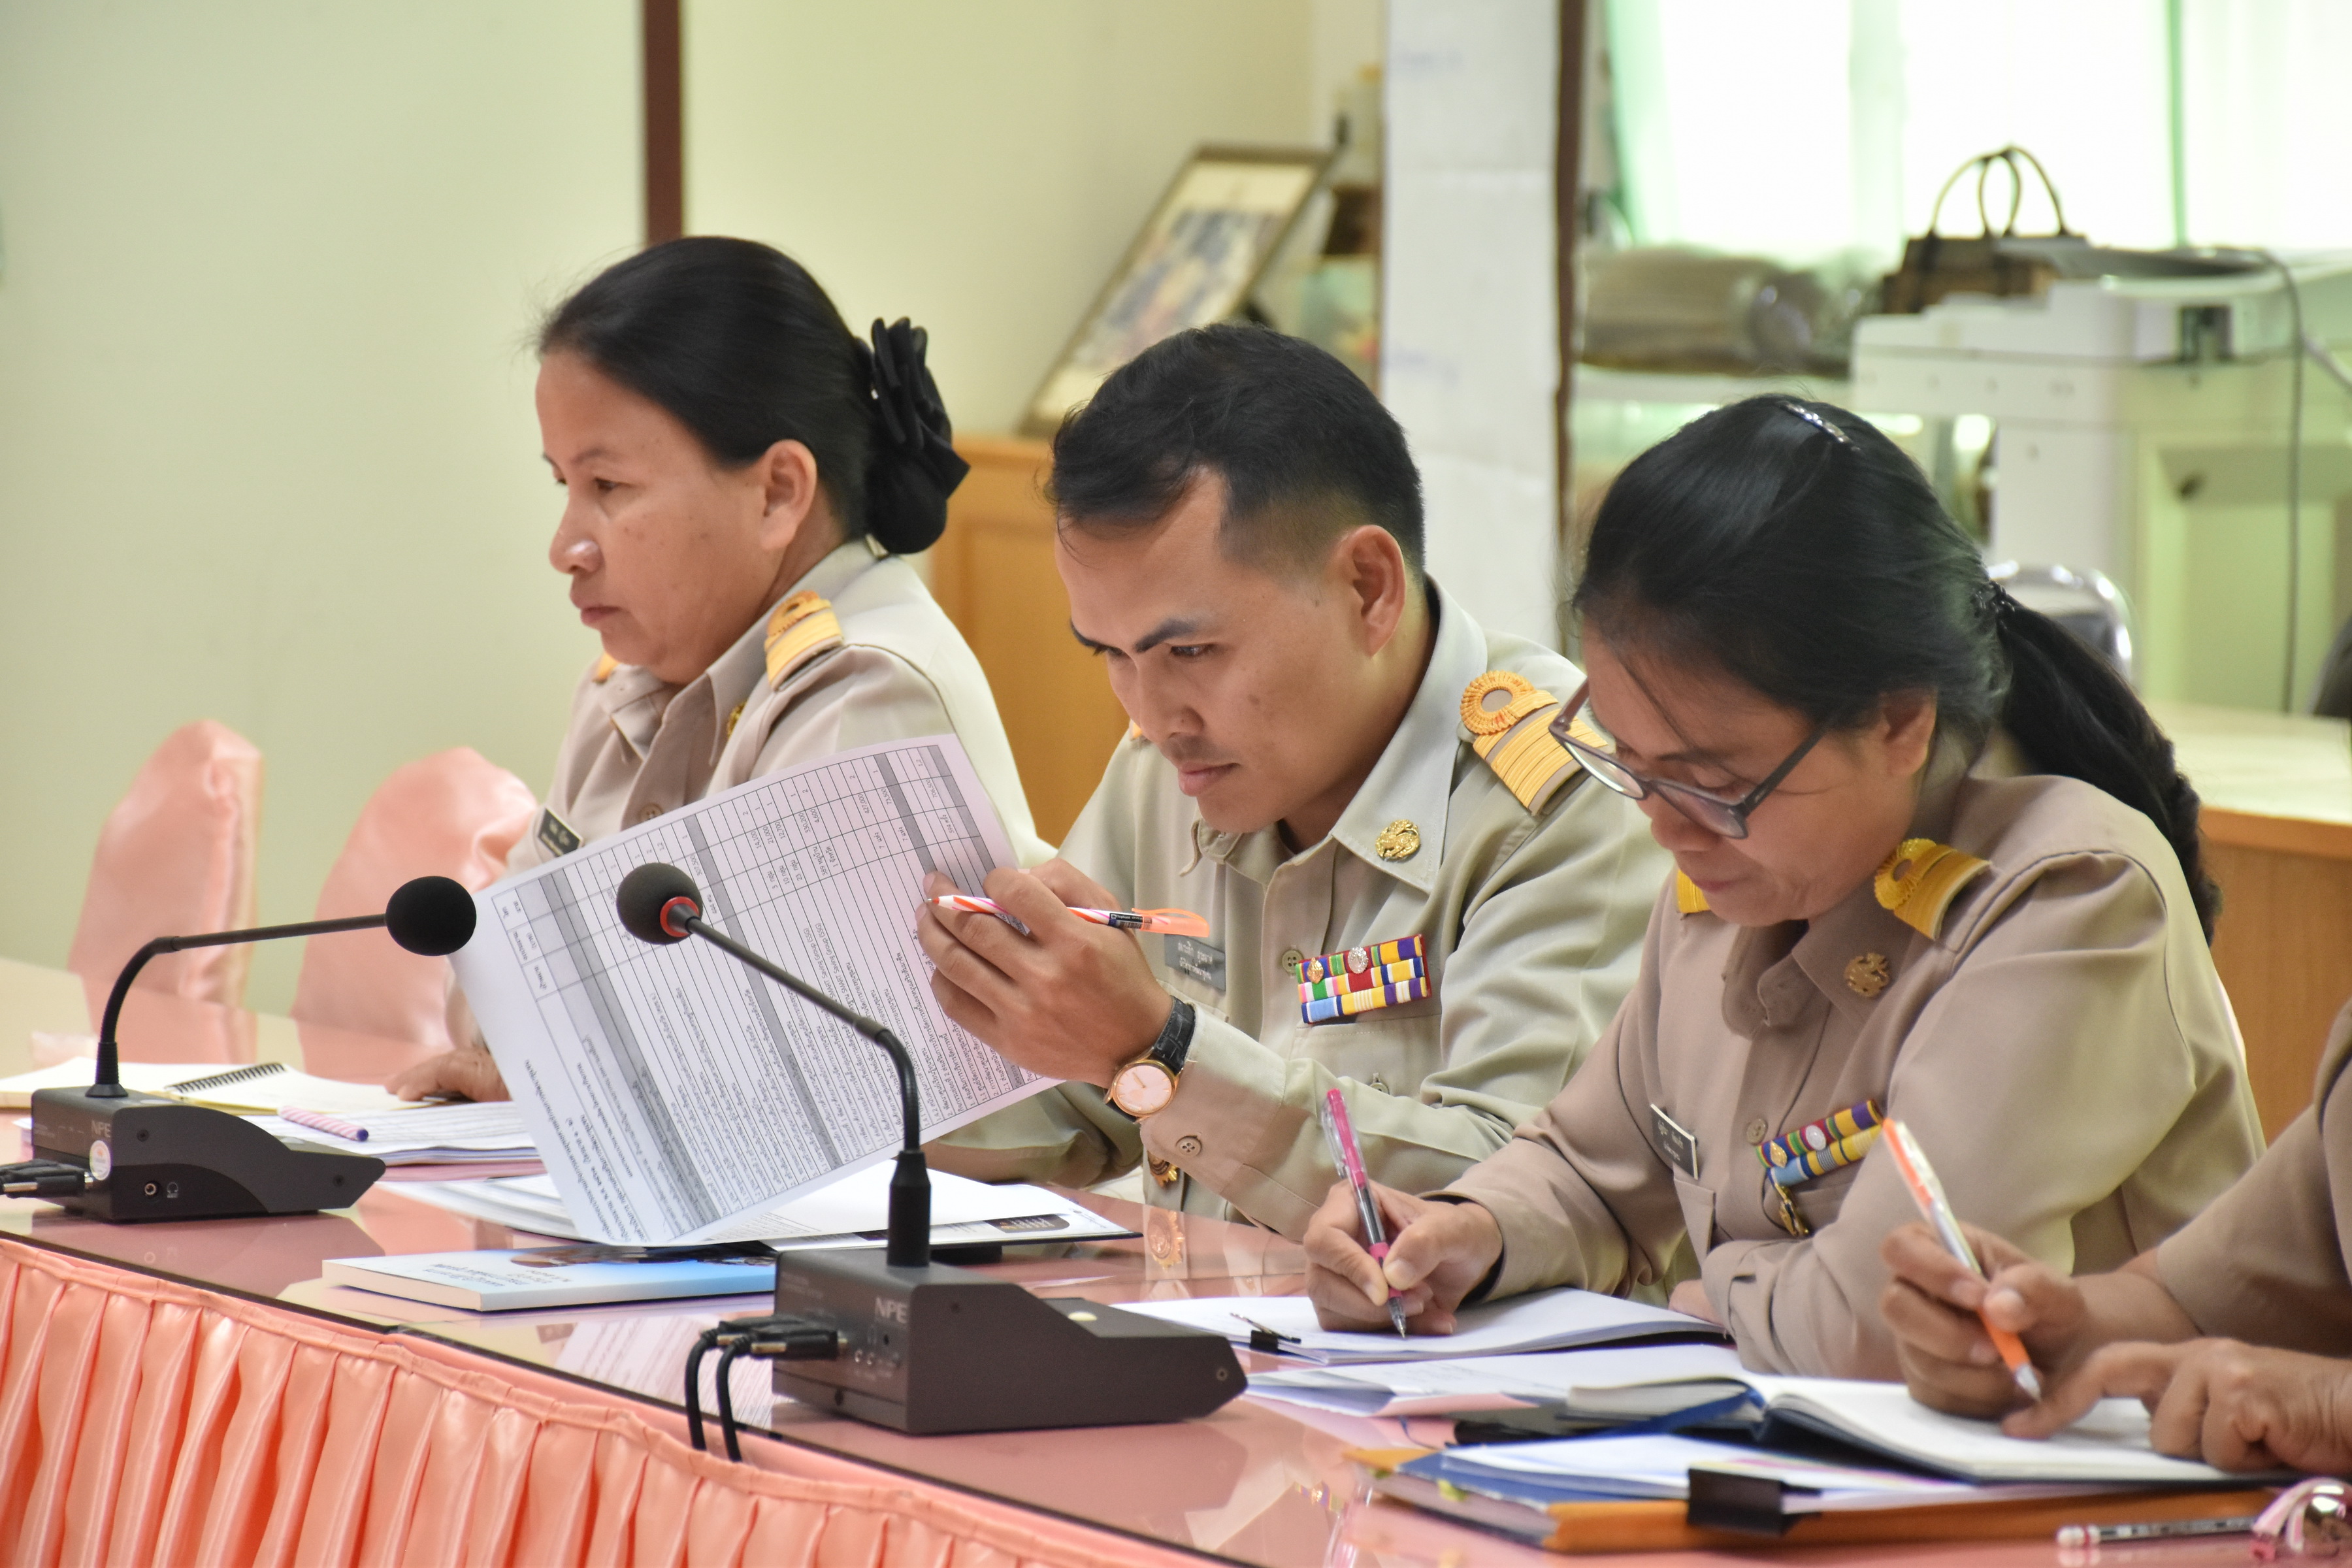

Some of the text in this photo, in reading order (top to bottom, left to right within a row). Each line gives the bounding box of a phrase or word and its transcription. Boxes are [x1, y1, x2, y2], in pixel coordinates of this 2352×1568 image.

[857, 792, 871, 814] 427,000
[880, 787, 892, 805] 73,500
[797, 811, 811, 834] 330,200
[808, 941, 822, 960] Group
[819, 936, 834, 956] Group
[815, 960, 829, 979] Saving
[826, 955, 841, 974] Saving
[823, 979, 836, 998] SMART
[834, 973, 848, 994] SMART
[91, 1120, 110, 1138] NPE
[875, 1297, 907, 1324] NPE
